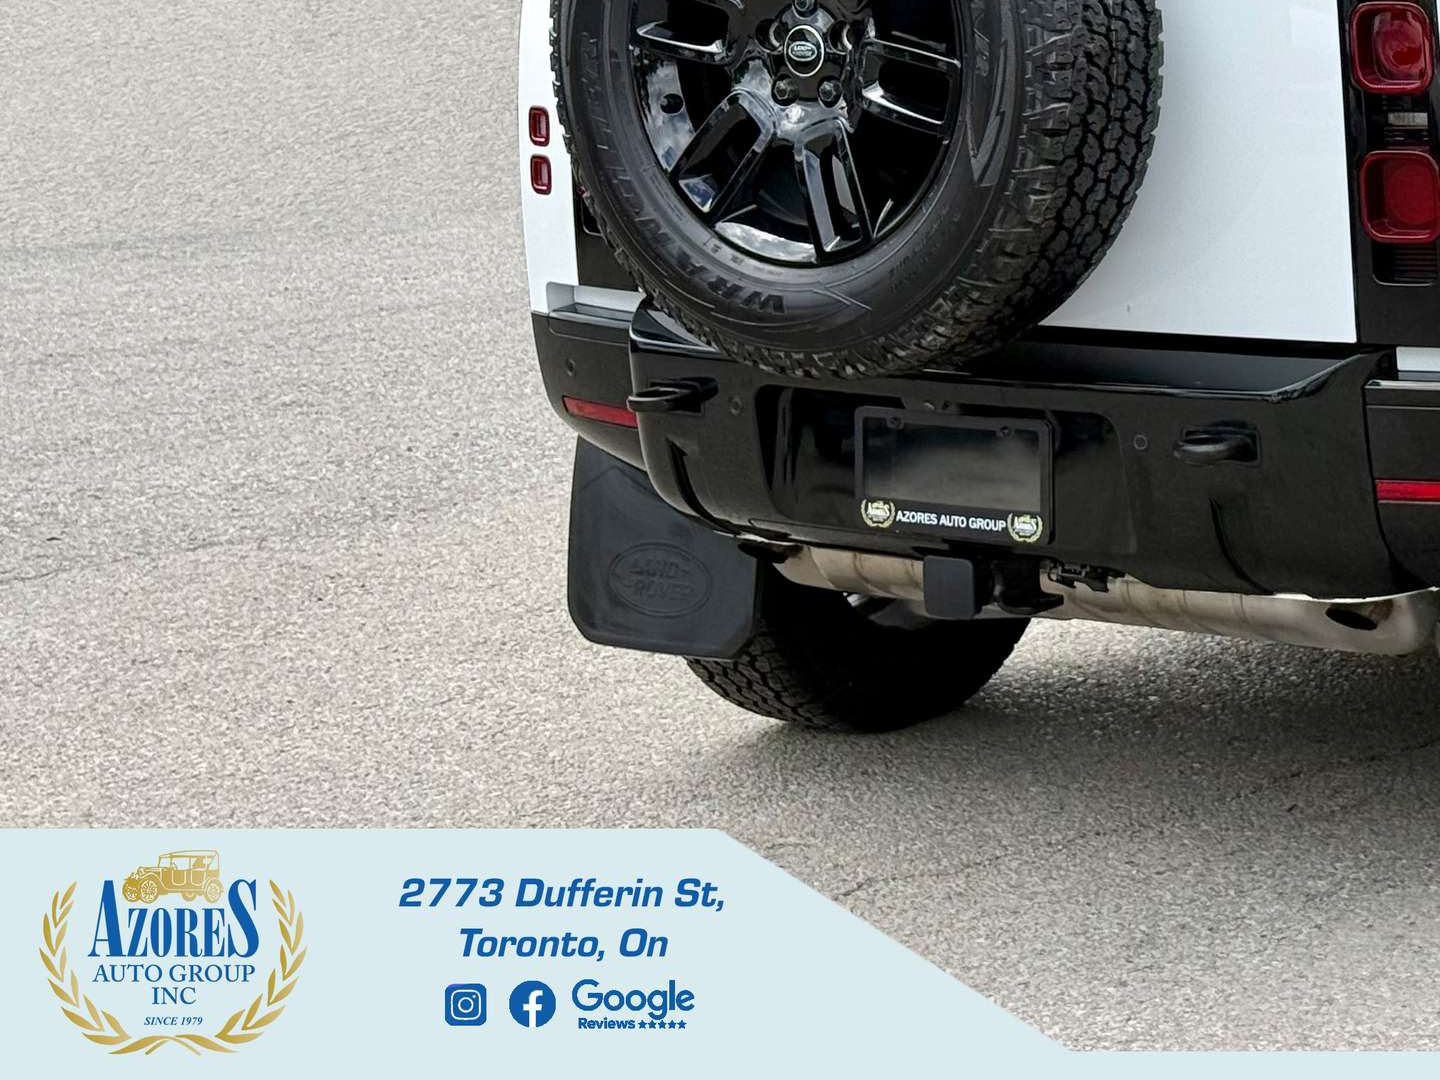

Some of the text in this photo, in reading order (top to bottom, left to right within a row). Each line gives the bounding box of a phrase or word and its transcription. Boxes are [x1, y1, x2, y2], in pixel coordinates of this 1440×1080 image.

[896, 510, 938, 525] AZORES
[939, 514, 967, 528] AUTO
[968, 517, 1007, 532] GROUP
